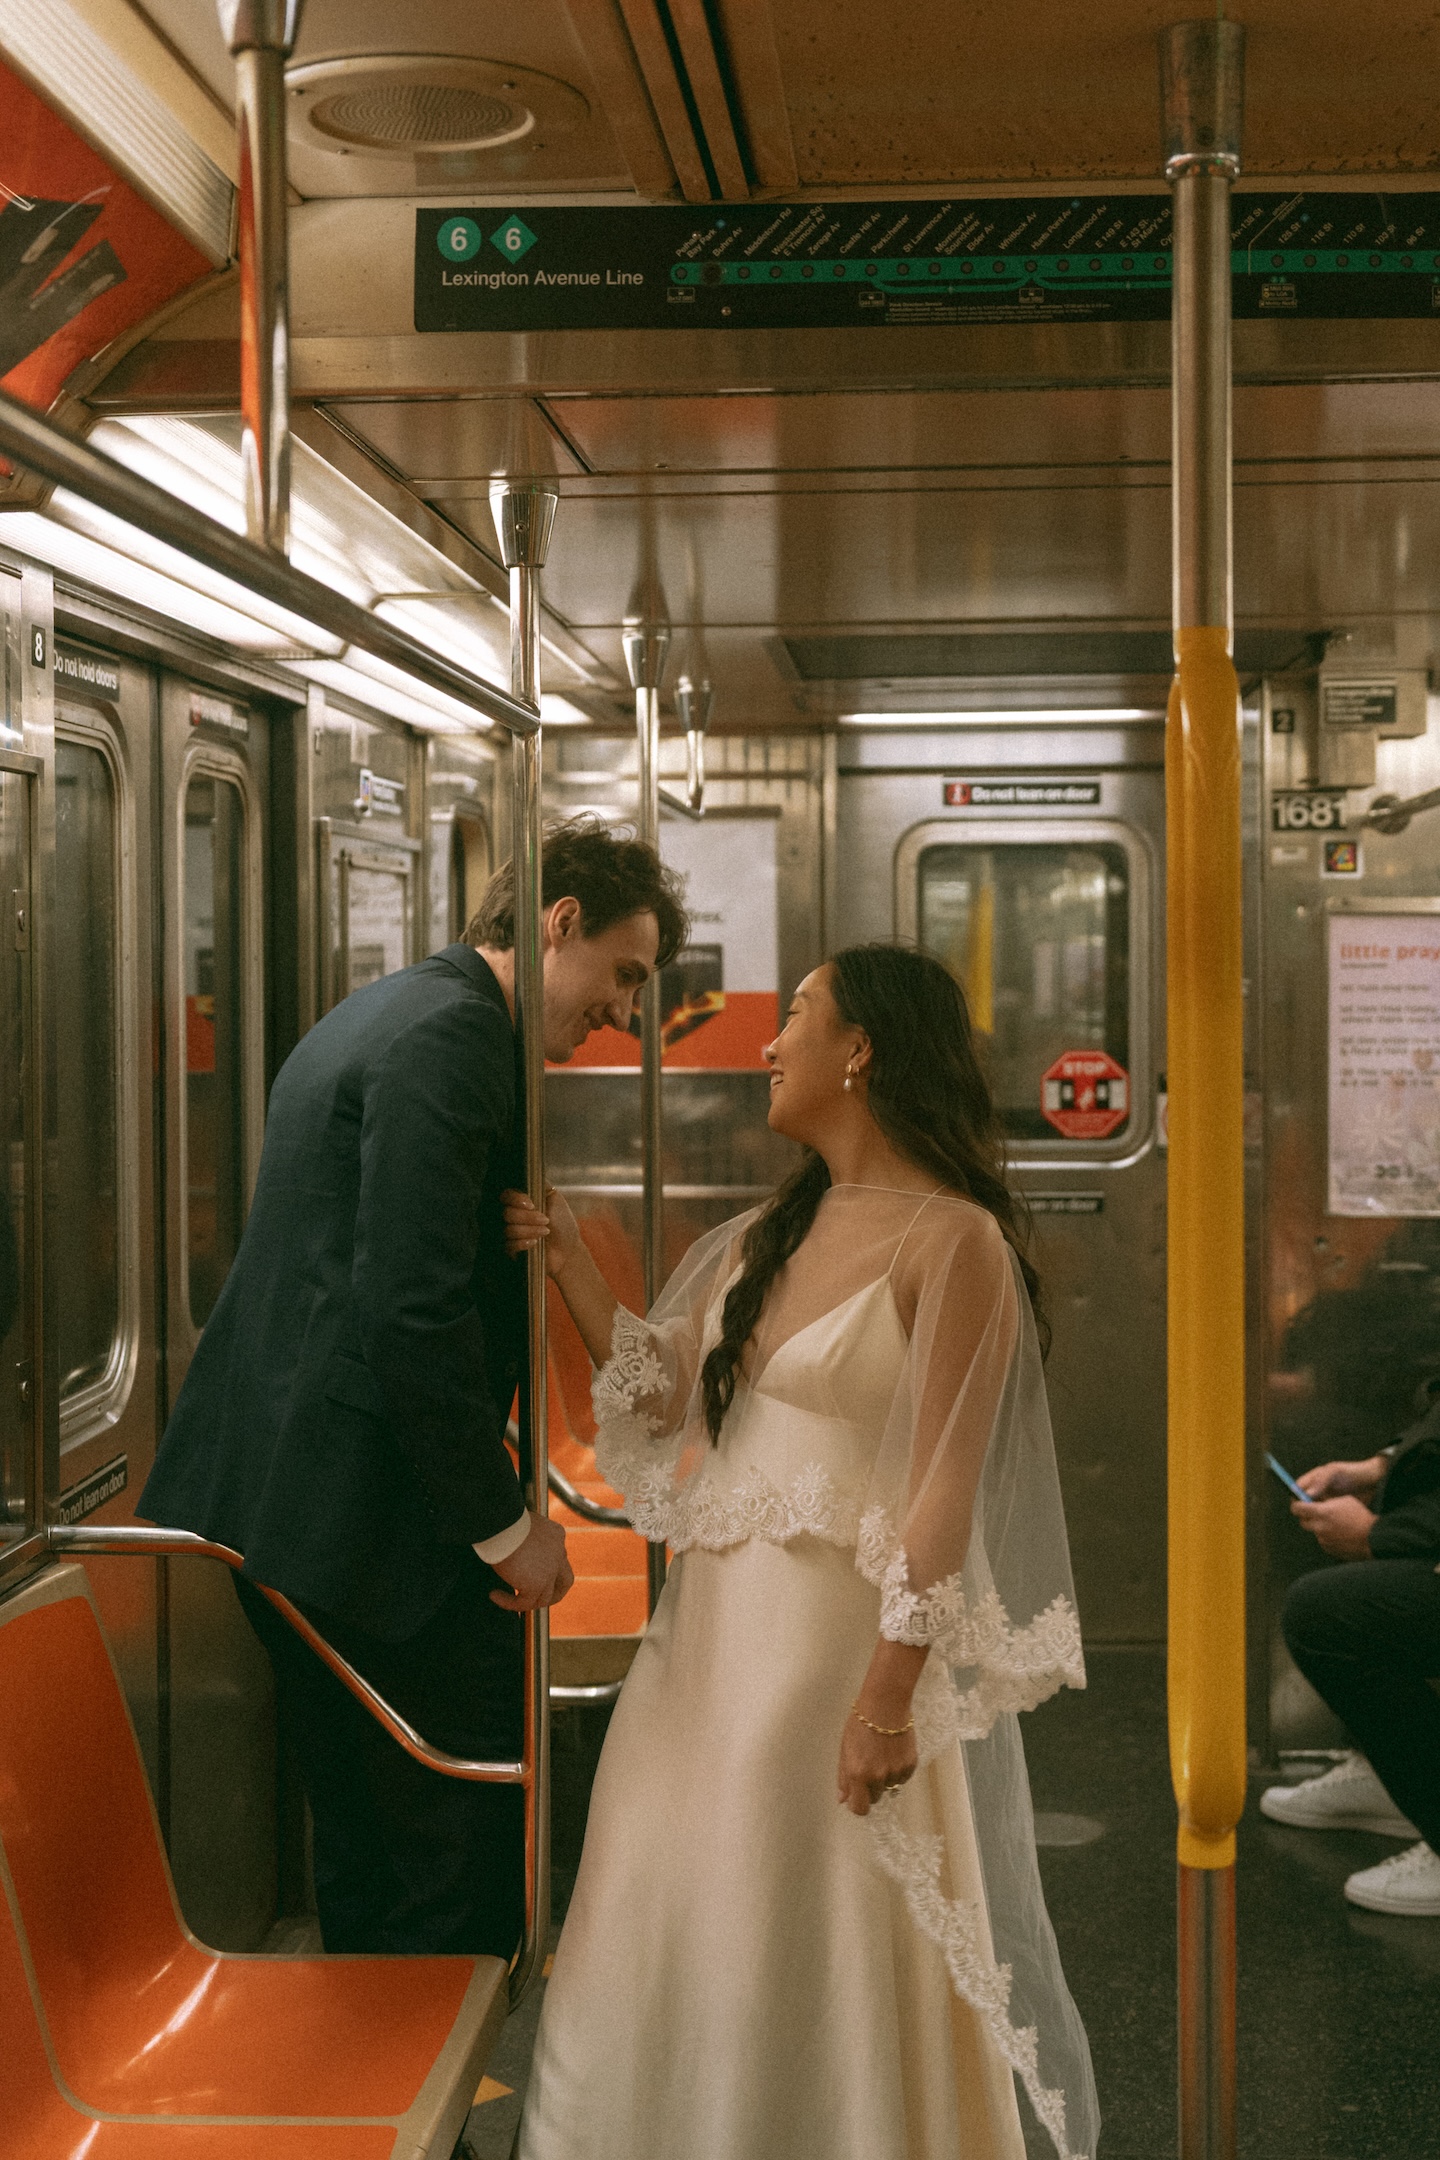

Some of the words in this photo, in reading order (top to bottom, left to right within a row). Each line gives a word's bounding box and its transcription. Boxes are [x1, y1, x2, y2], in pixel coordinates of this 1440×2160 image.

[1063, 214, 1099, 250] Longwood
[1096, 204, 1108, 216] Av
[1253, 207, 1264, 218] St
[451, 227, 467, 251] 6
[505, 227, 521, 251] 6
[712, 236, 734, 257] Buhre
[732, 227, 743, 238] Av
[743, 218, 782, 256] Middletown
[779, 207, 792, 221] Rd
[771, 215, 812, 255] Westchester
[783, 248, 791, 257] E
[789, 222, 817, 250] Tremont
[815, 213, 827, 225] Av
[807, 231, 833, 255] Zerega
[830, 221, 841, 233] Av
[839, 232, 862, 254] Castle
[859, 220, 873, 234] Hill
[870, 212, 882, 223] Av
[871, 214, 909, 253] Parkchester
[902, 243, 914, 253] St
[911, 212, 943, 245] Lawrence
[941, 203, 952, 215] Av
[934, 222, 965, 253] Morrison
[944, 218, 981, 255] Soundview
[966, 233, 986, 252] Elder
[983, 223, 995, 235] Av
[998, 222, 1028, 251] Whitlock
[1026, 212, 1038, 224] Av
[1030, 230, 1050, 250] Hunts
[1047, 216, 1064, 233] Point
[1061, 208, 1073, 219] Av
[1095, 240, 1104, 249] E
[1101, 227, 1116, 242] 149
[1113, 219, 1124, 230] St
[1119, 239, 1128, 248] E
[1125, 227, 1141, 241] 143
[1131, 238, 1142, 248] St
[1160, 208, 1171, 218] St
[1278, 230, 1293, 243] 125
[1290, 221, 1301, 232] St
[1311, 229, 1326, 243] 116
[1323, 222, 1334, 232] St
[1343, 230, 1358, 243] 110
[1355, 223, 1366, 233] St
[1375, 231, 1389, 245] 103
[1387, 224, 1397, 234] St
[1406, 234, 1418, 246] 96
[1415, 226, 1426, 236] St
[676, 233, 701, 257] Pelha
[687, 244, 702, 258] Bay
[699, 229, 717, 245] Park
[442, 271, 529, 289] Lexington
[534, 271, 600, 286] Avenue
[606, 269, 644, 285] Line
[35, 632, 43, 662] 8
[64, 657, 78, 677] not
[78, 657, 95, 683] hold
[96, 665, 117, 690] doors
[1276, 712, 1290, 731] 2
[971, 786, 991, 802] Do
[991, 787, 1014, 801] not
[1016, 786, 1044, 801] lean
[1044, 788, 1061, 801] on
[1062, 786, 1096, 801] door
[1272, 796, 1347, 828] 1681
[1340, 944, 1390, 959] little
[1063, 1061, 1107, 1076] STOP
[70, 1496, 83, 1521] not
[84, 1489, 99, 1511] lean
[99, 1482, 109, 1500] on
[109, 1471, 125, 1493] door
